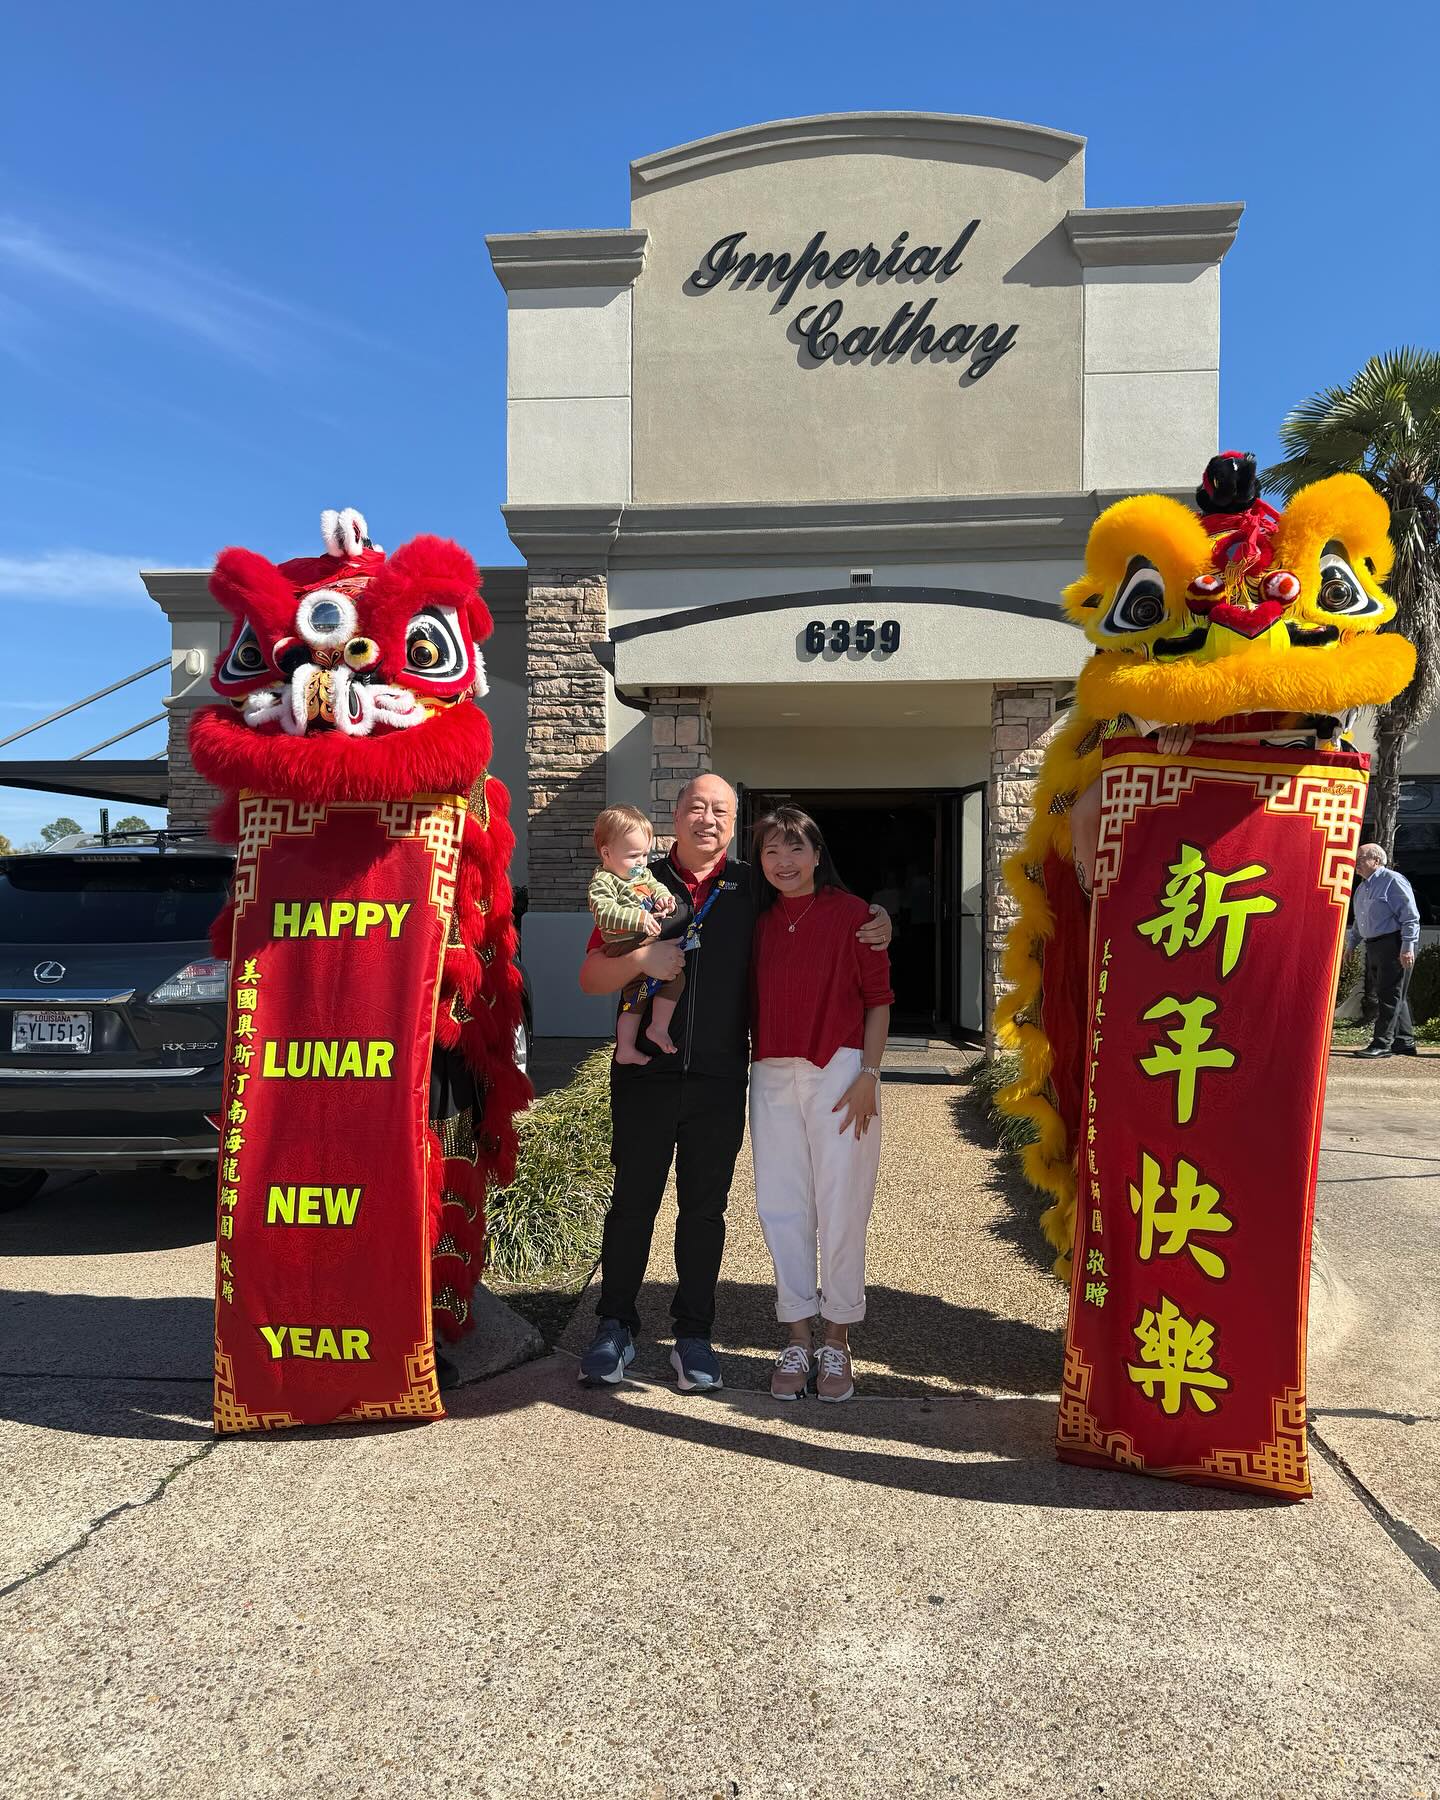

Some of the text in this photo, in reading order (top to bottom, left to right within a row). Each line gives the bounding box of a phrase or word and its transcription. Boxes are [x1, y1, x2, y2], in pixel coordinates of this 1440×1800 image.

[691, 219, 981, 306] Imperial
[795, 297, 1020, 379] Cathay
[805, 619, 901, 655] 6359
[273, 901, 411, 938] HAPPY
[29, 1022, 86, 1042] YLT513
[34, 1014, 71, 1023] LOUISIANA
[262, 1040, 395, 1078] LUNAR
[1128, 843, 1278, 1414] 新年快樂
[266, 1186, 362, 1225] NEW
[259, 1326, 370, 1360] YEAR
